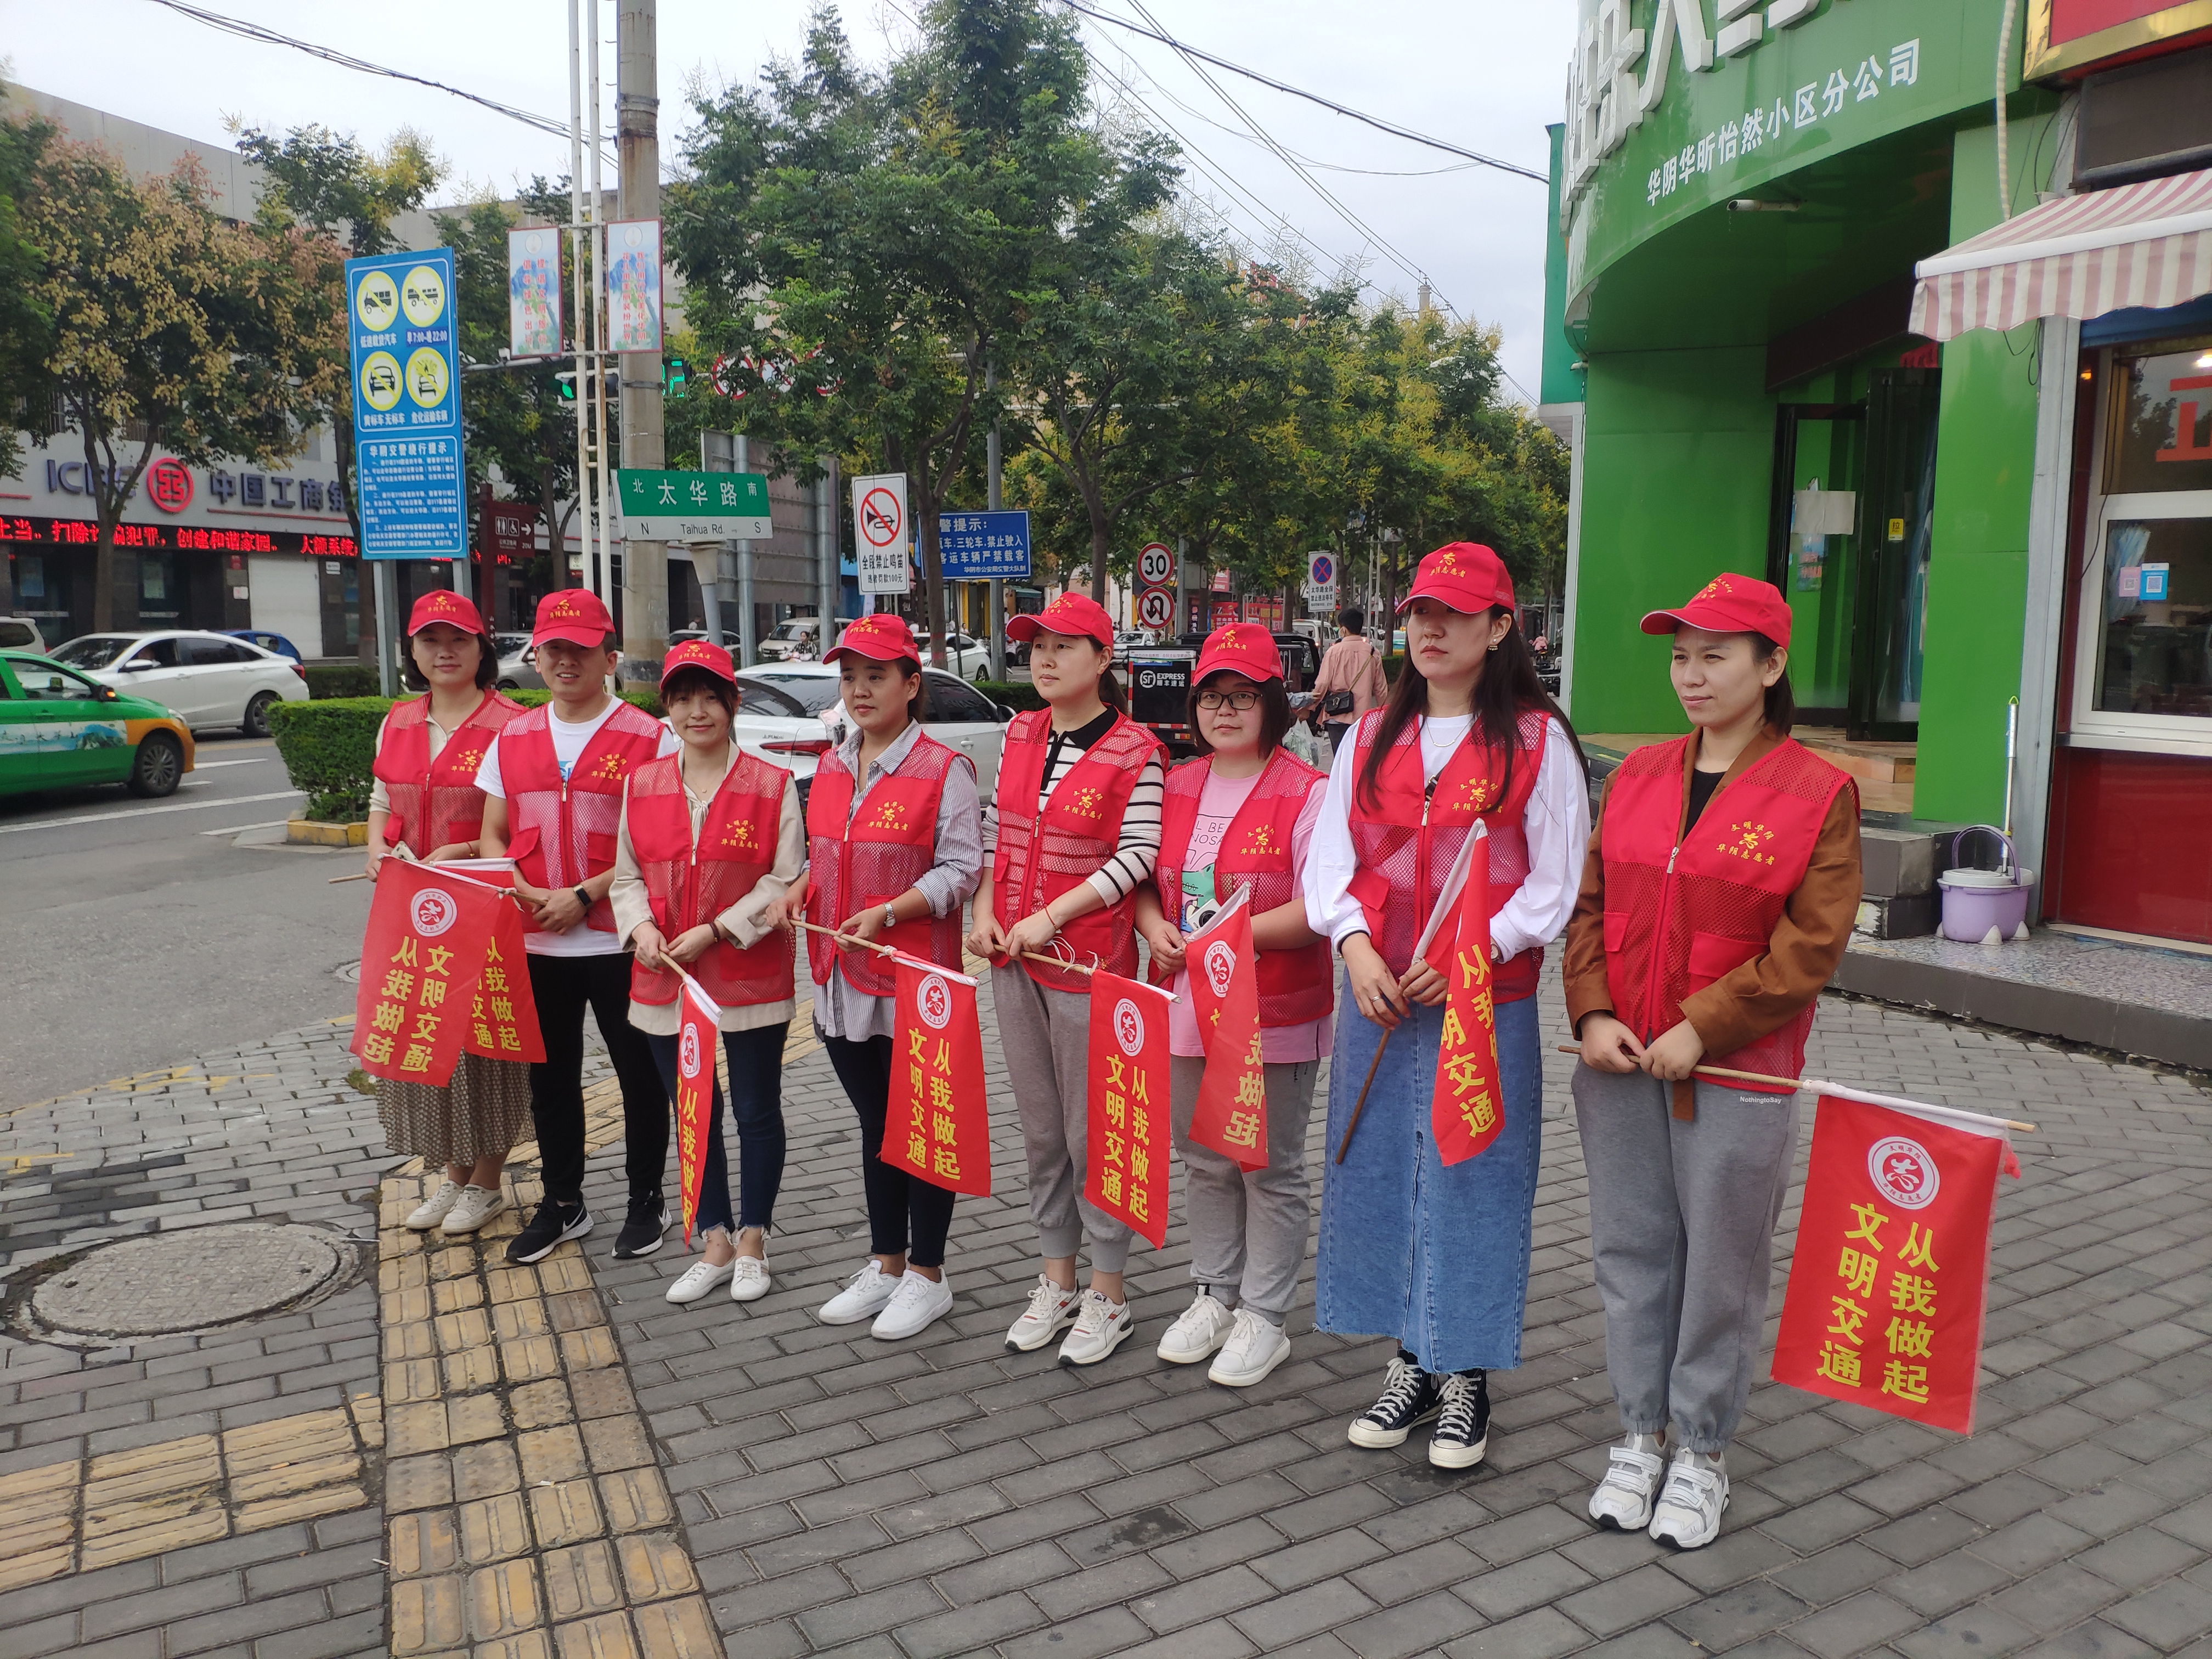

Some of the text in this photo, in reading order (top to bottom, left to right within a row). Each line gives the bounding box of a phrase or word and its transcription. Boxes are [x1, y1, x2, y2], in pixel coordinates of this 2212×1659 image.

[1647, 37, 1920, 207] 华阴华昕怡然小区分公司
[633, 478, 644, 493] 北
[658, 478, 737, 507] 太华路
[747, 482, 757, 496] 南
[641, 523, 649, 535] N
[681, 524, 725, 534] Taihua Rd.
[755, 522, 761, 533] S
[862, 554, 903, 569] 全段禁止鸣笛
[1145, 555, 1166, 575] 30
[1208, 822, 1225, 832] BE
[1716, 843, 1775, 866] 华阴志愿者
[907, 1028, 927, 1169] 文明交通
[930, 1038, 961, 1180] 从我做起
[1740, 1096, 1782, 1104] NothingtoSay
[1102, 1054, 1126, 1206] 文明交通
[1128, 1066, 1150, 1223] 从我做起
[1816, 1203, 1889, 1387] 文明交通
[1881, 1222, 1940, 1404] 从我做起
